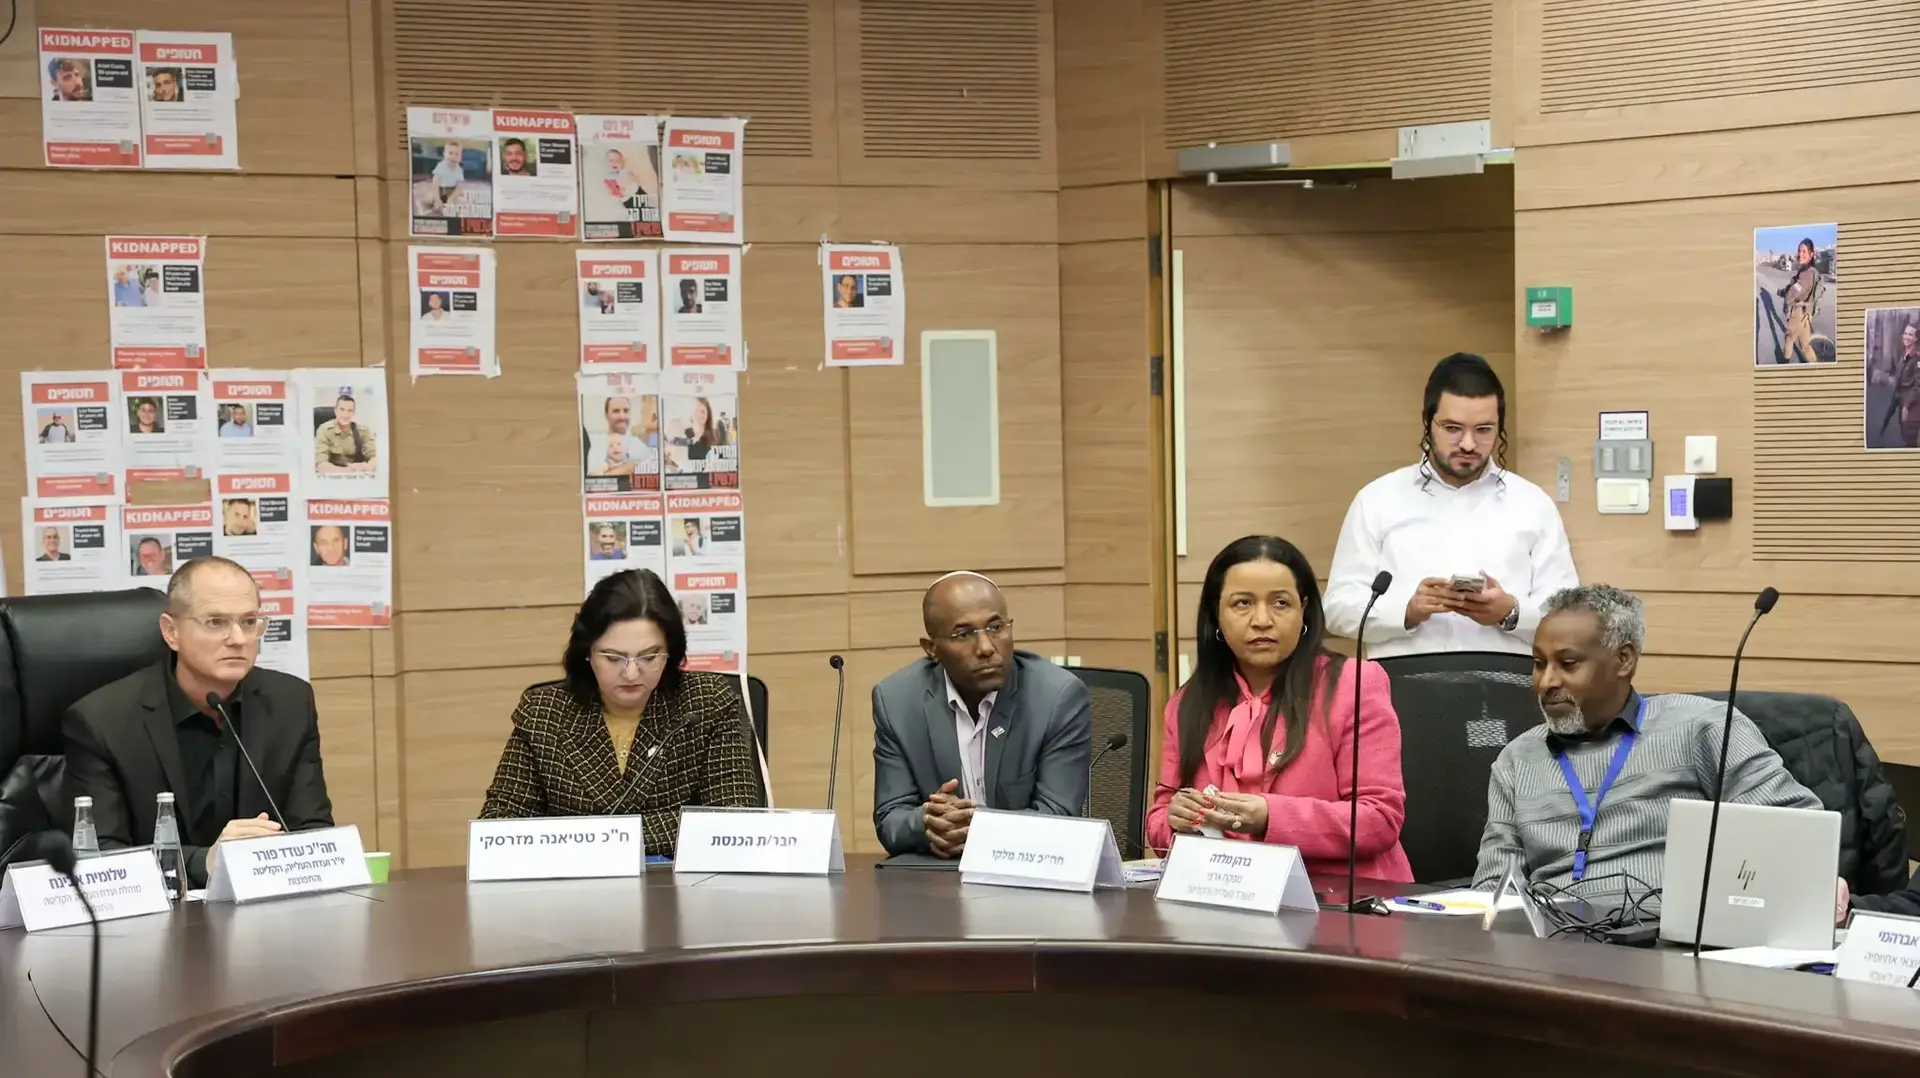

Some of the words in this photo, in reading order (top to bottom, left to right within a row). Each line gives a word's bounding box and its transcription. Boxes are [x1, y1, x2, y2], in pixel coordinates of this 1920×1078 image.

[44, 34, 131, 48] KIDNAPPED
[156, 48, 202, 59] חטופים
[496, 115, 569, 129] KIDNAPPED
[682, 134, 721, 145] חטופים
[112, 242, 197, 253] KIDNAPPED
[681, 260, 718, 271] חטופים
[842, 256, 880, 266] חטופים
[592, 265, 632, 275] חטופים
[137, 375, 184, 387] חטופים
[47, 388, 94, 399] חטופים
[228, 385, 272, 395] חטופים
[232, 477, 276, 489] חטופים
[588, 500, 660, 511] KIDNAPPED
[669, 496, 740, 508] KIDNAPPED
[309, 503, 389, 515] KIDNAPPED
[126, 510, 211, 523] KIDNAPPED
[687, 576, 726, 587] חטופים
[480, 834, 534, 849] מזרסקי
[540, 832, 596, 845] טטיאנה
[711, 835, 753, 846] הכנסת
[756, 834, 797, 847] חבר/ת
[252, 849, 277, 862] פורר
[278, 846, 304, 858] עודד
[1209, 853, 1233, 864] מלדה
[85, 868, 128, 885] שלומית
[1738, 860, 1756, 890] hp
[1879, 931, 1920, 946] אברהמי
